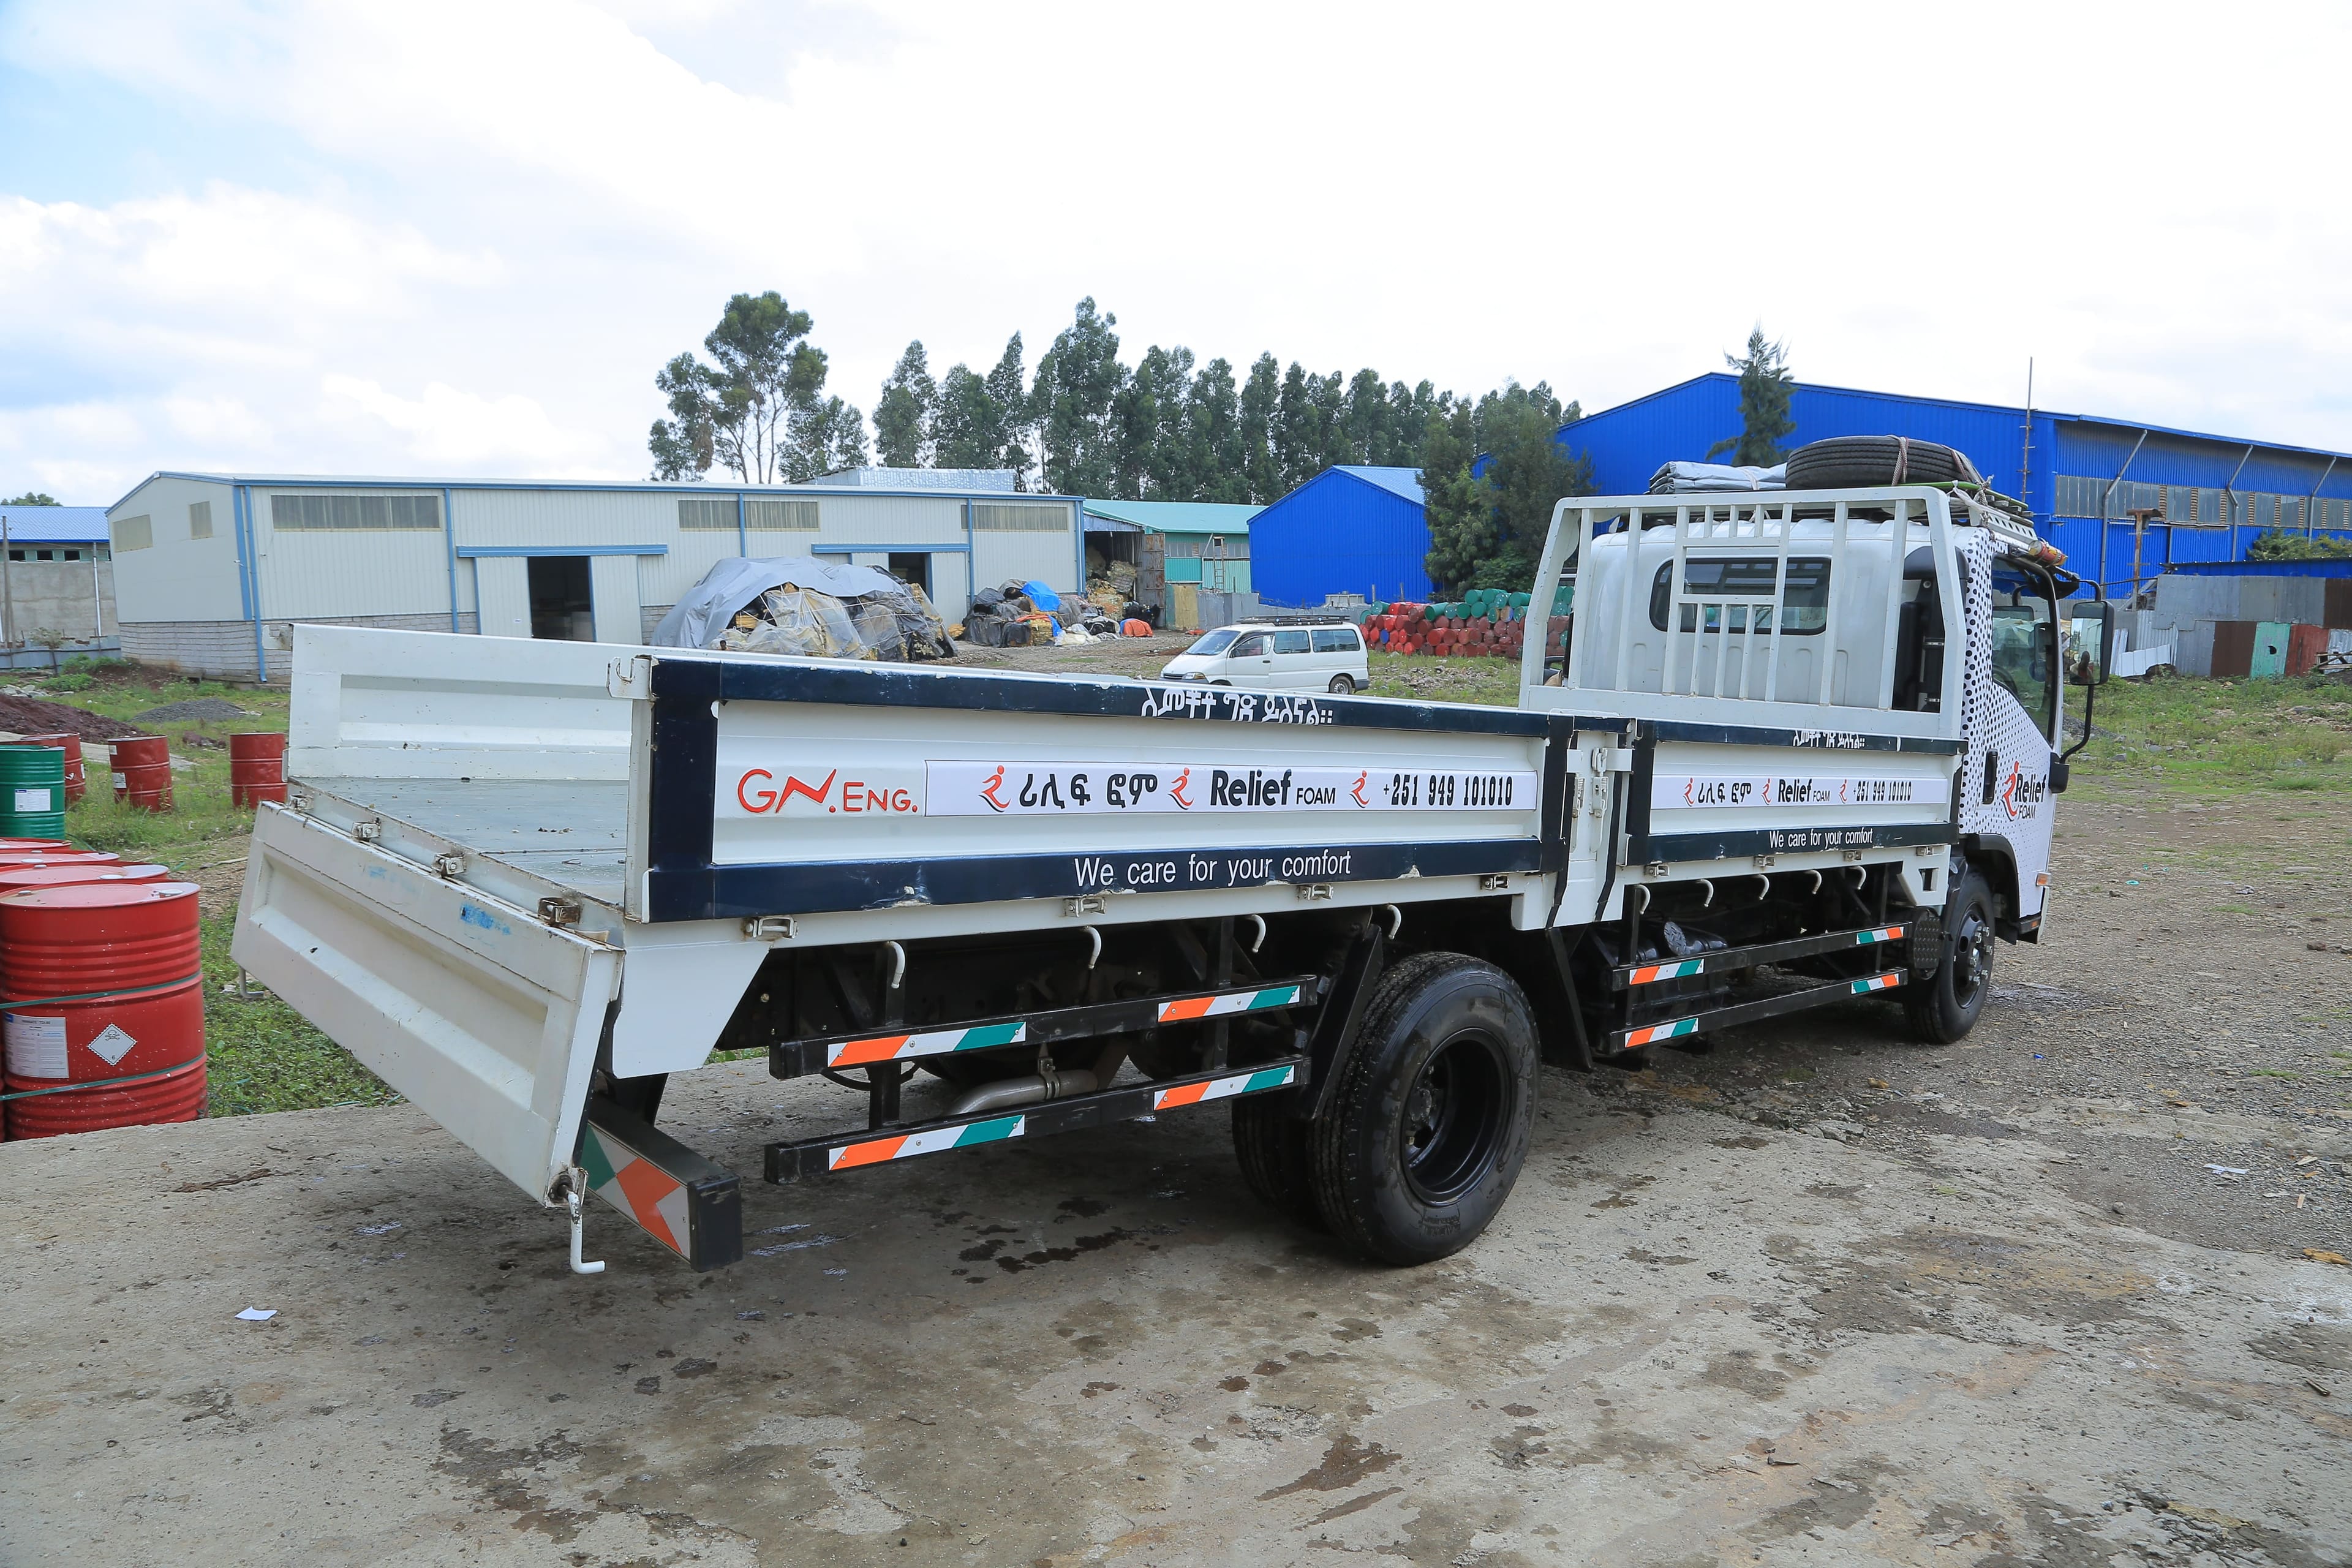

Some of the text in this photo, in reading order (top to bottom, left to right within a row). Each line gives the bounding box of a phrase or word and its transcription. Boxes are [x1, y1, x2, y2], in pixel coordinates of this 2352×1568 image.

[1107, 774, 1158, 809] ፎም
[1210, 769, 1336, 807] Relief FOAM
[1383, 774, 1513, 806] +251 949 101010
[1731, 782, 1752, 804] ፎም
[1777, 778, 1830, 802] Relief FOAM
[1853, 781, 1912, 802] +251 949 101010
[2015, 773, 2046, 803] Relief
[2018, 804, 2037, 820] FOAM
[1769, 827, 1873, 849] We care for your comfort
[1074, 850, 1352, 887] We care for your comfort
